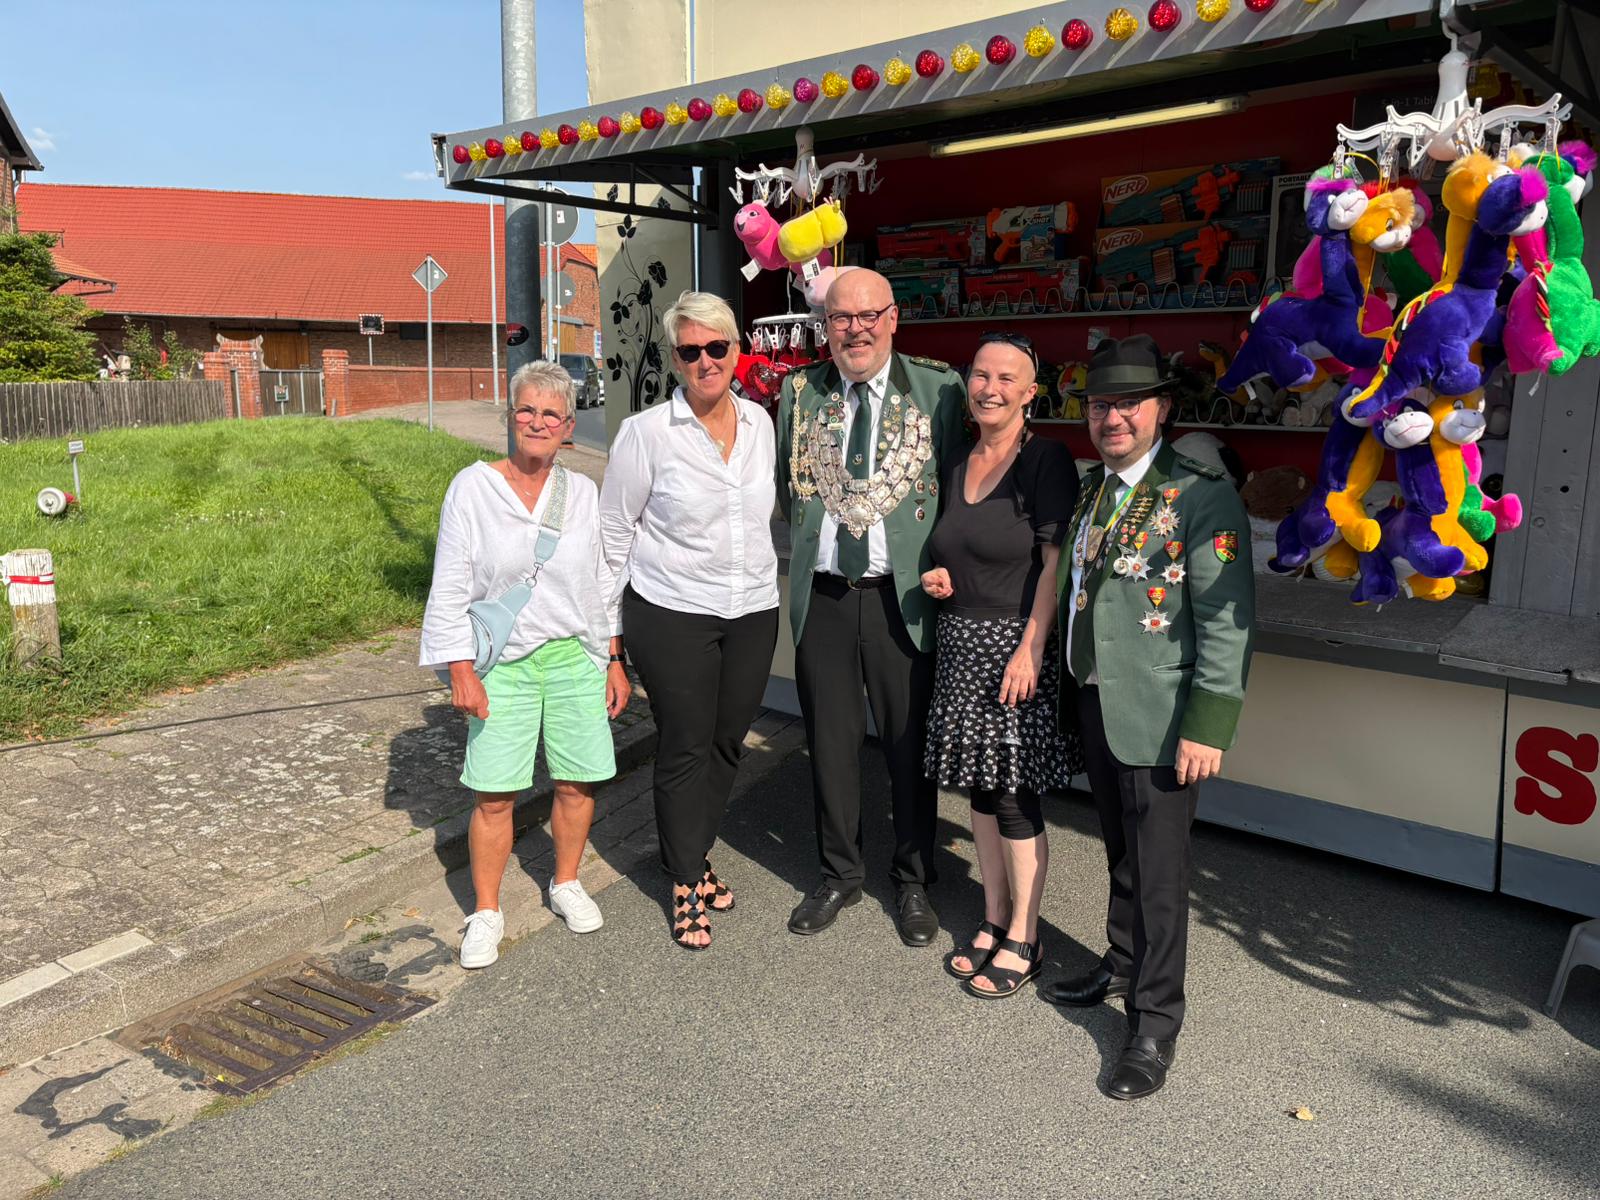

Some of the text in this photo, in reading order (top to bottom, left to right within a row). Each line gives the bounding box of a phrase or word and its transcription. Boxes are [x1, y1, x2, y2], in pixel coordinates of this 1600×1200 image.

[1104, 178, 1147, 202] NERF
[1099, 230, 1142, 252] NERF
[1514, 726, 1599, 825] S
